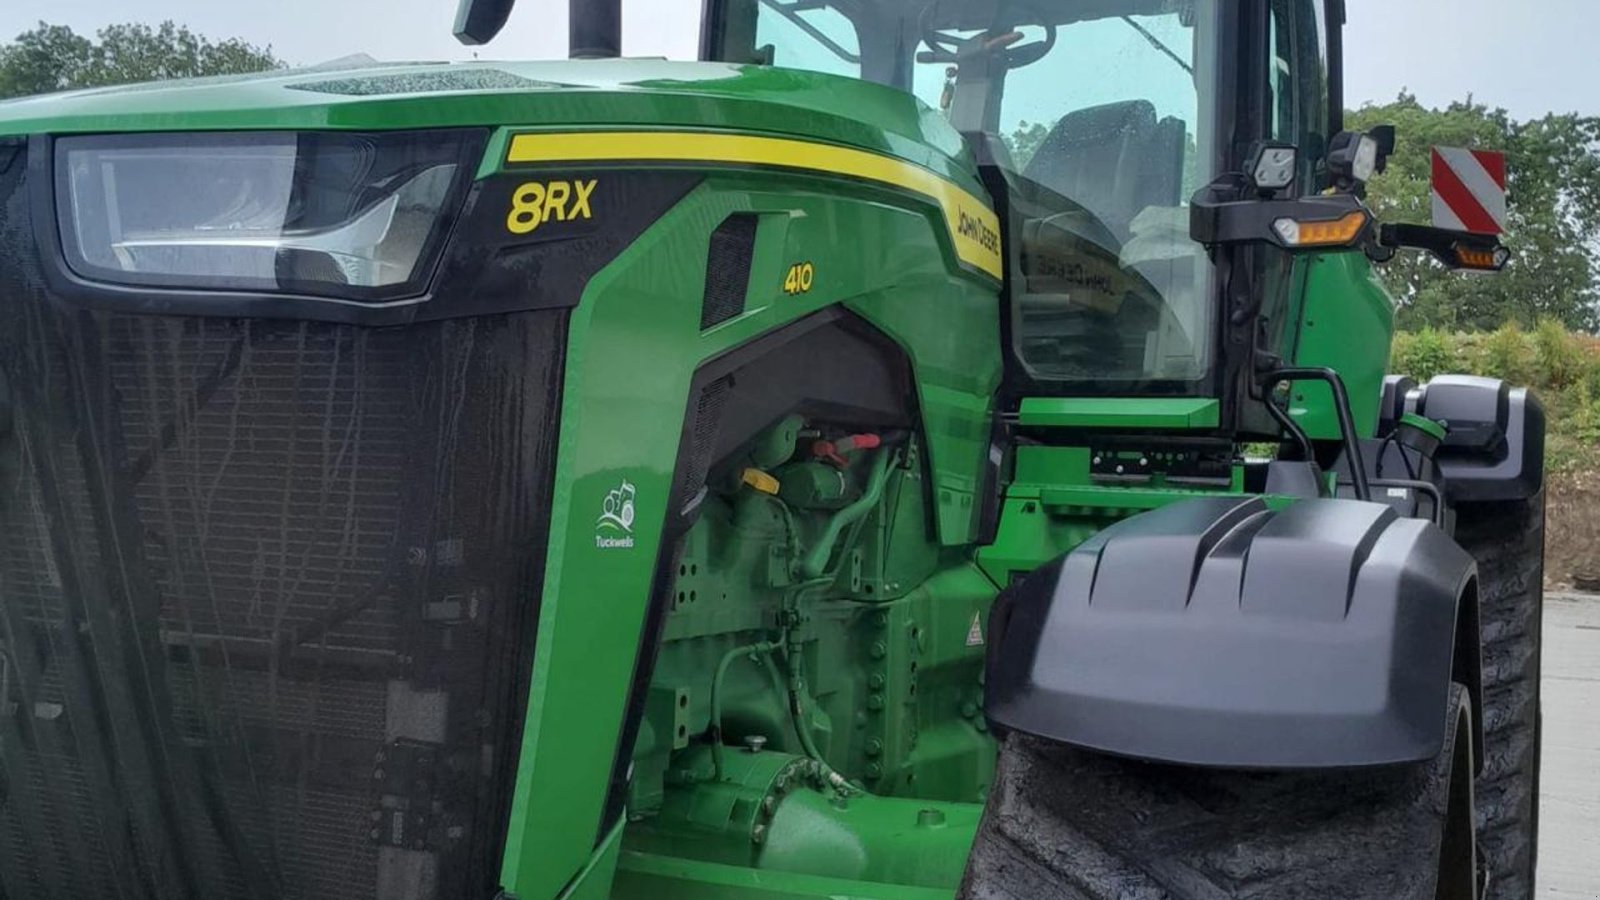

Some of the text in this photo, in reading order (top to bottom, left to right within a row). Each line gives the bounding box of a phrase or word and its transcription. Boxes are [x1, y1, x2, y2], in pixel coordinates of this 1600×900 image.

[507, 179, 598, 234] 8RX
[957, 204, 999, 256] JOHN DEERE
[784, 262, 812, 294] 410
[595, 535, 634, 548] Tuckwells
